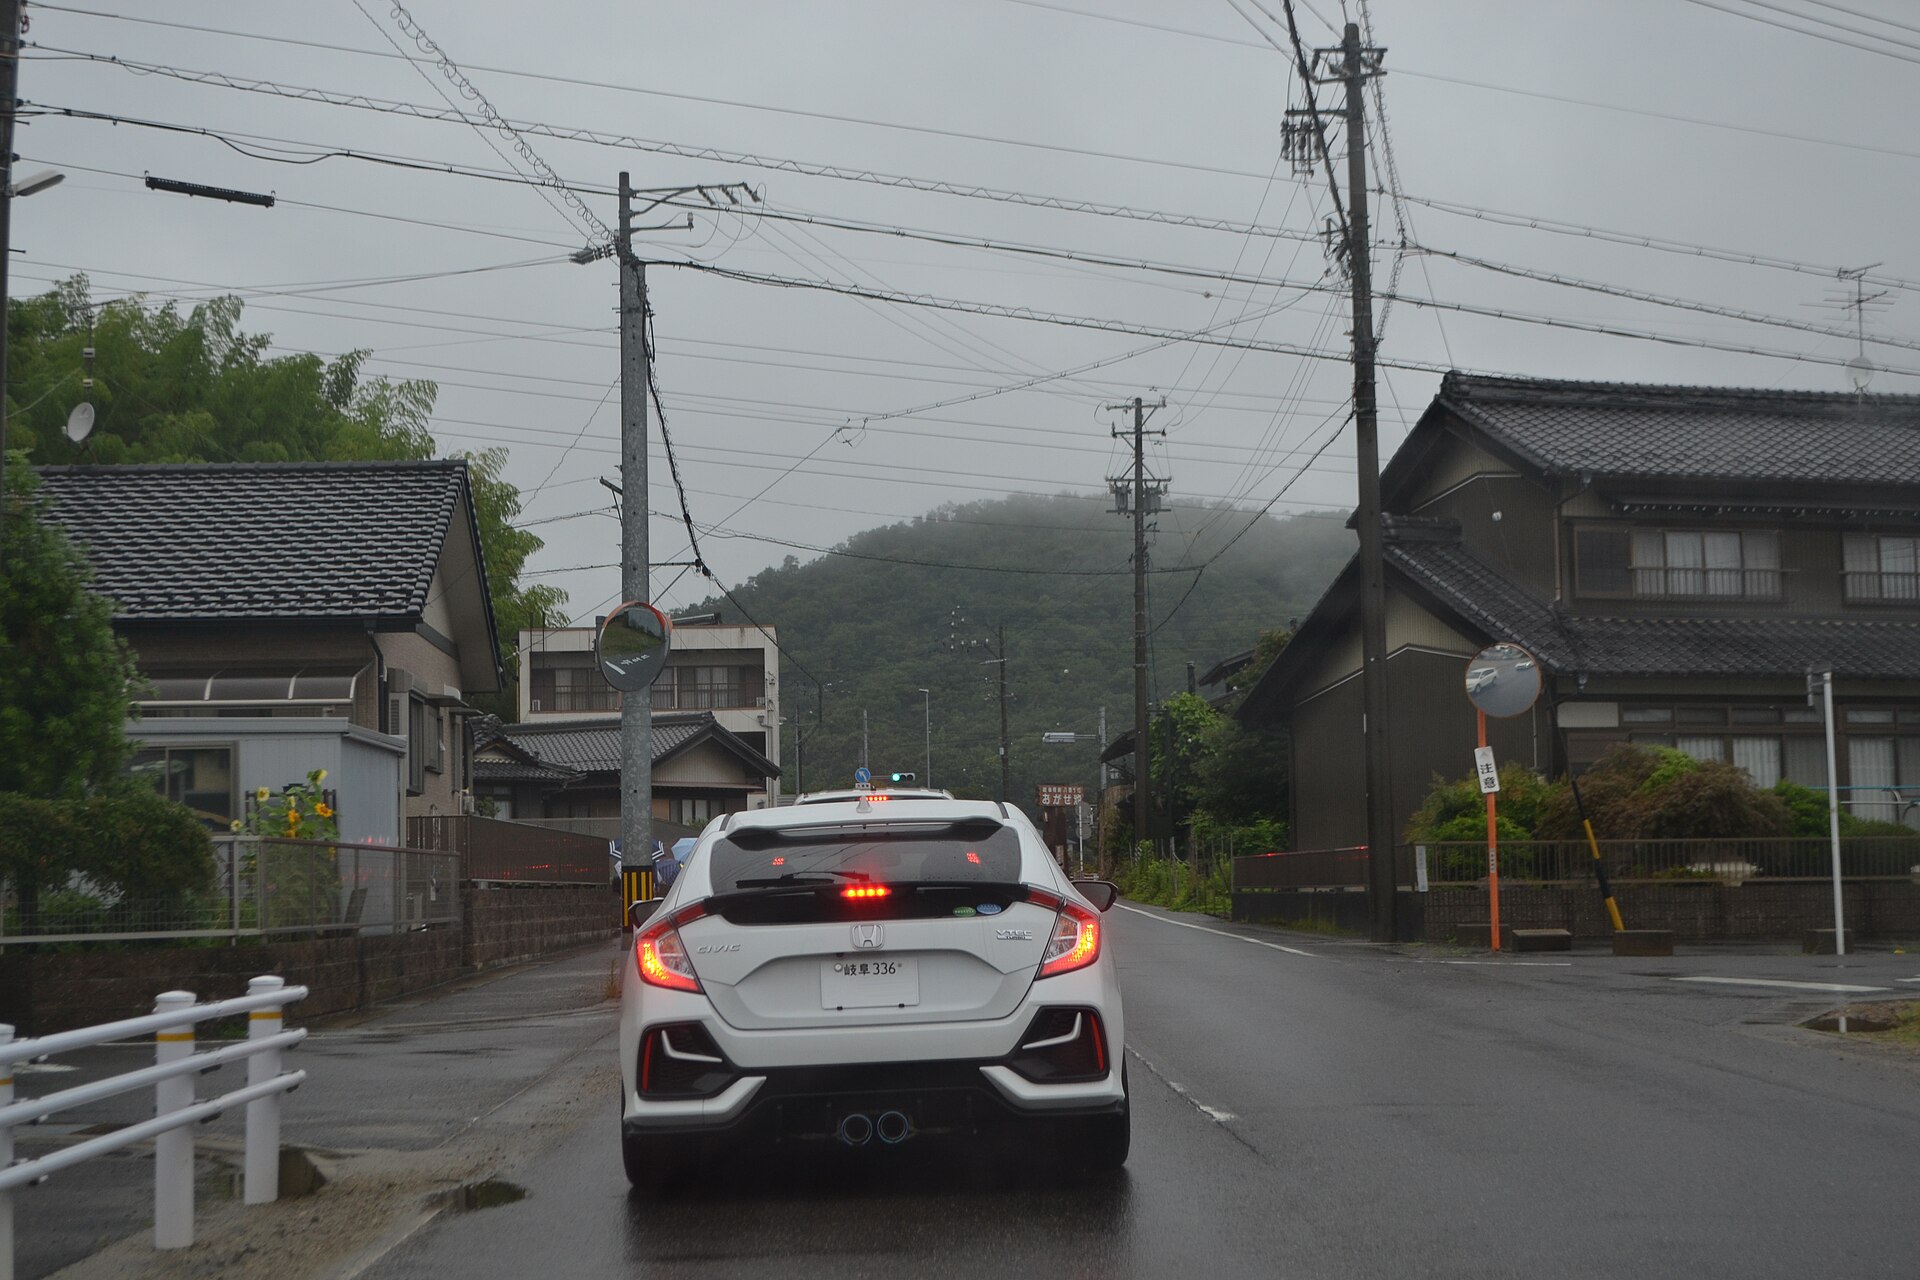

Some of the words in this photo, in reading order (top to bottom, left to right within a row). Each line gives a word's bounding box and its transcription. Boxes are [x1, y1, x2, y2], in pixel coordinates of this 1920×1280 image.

[1479, 763, 1496, 789] 注意
[697, 943, 741, 954] CIVIC
[843, 963, 870, 976] 岐阜
[872, 962, 896, 975] 336
